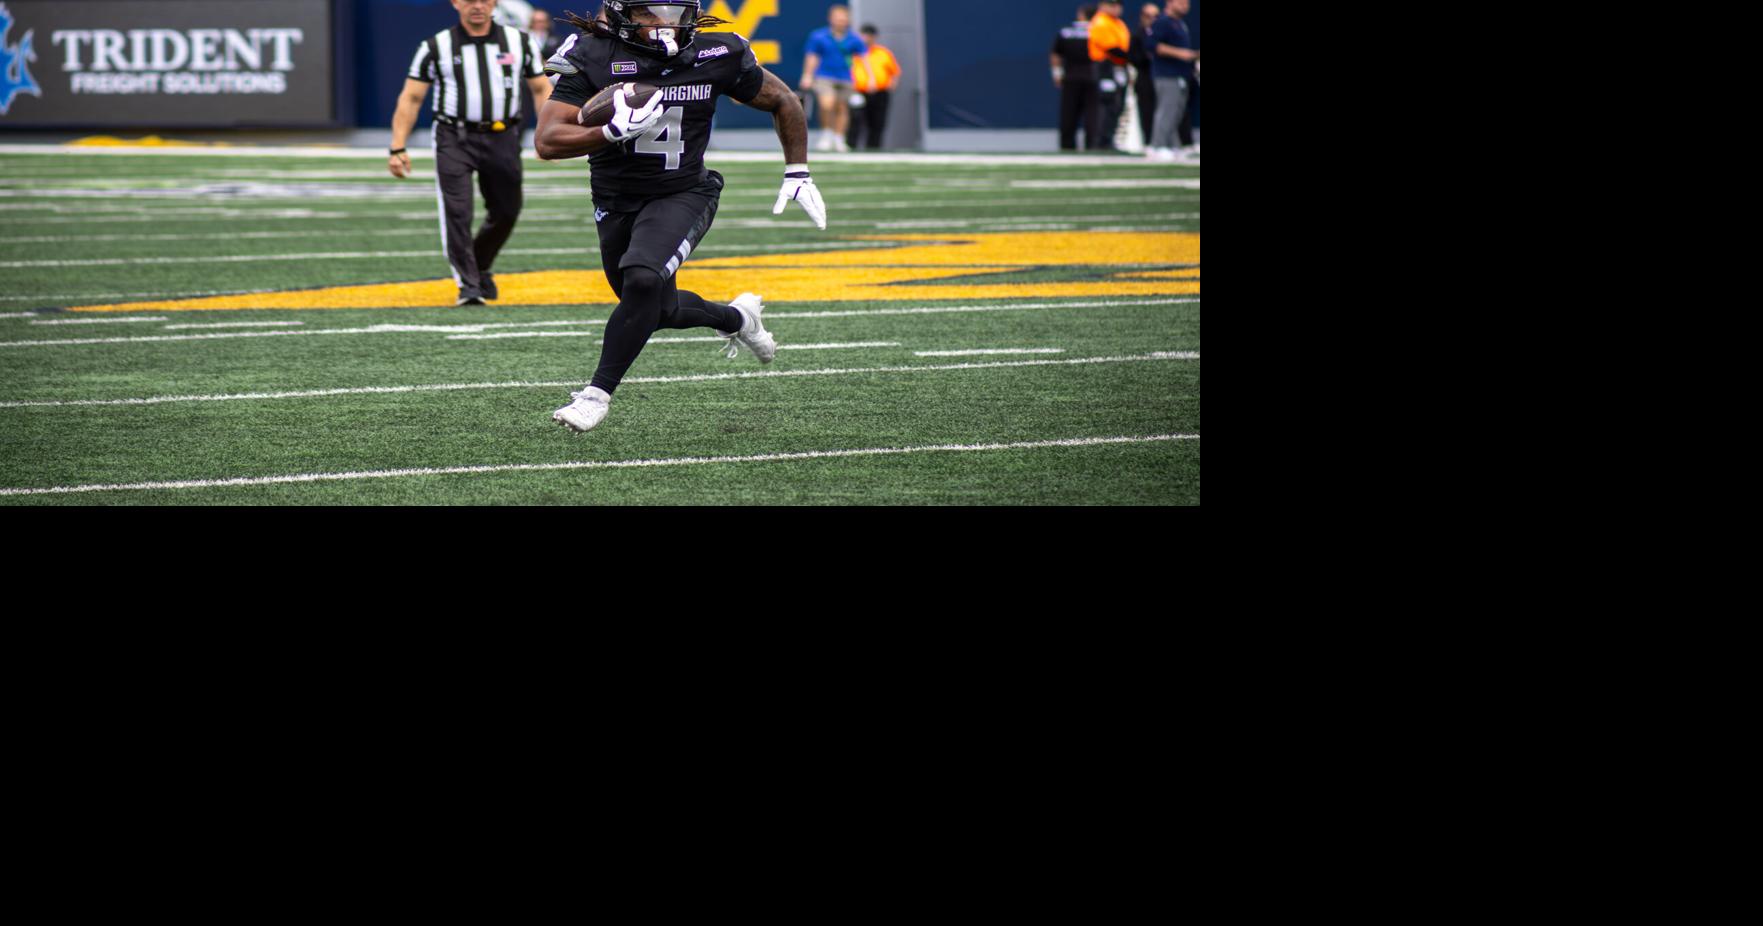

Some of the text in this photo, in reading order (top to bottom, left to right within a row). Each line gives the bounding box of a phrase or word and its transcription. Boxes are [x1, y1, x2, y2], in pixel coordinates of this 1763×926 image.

[52, 28, 303, 71] TRIDENT
[71, 72, 287, 93] FREIGHT SOLUTIONS
[634, 106, 685, 170] 4
